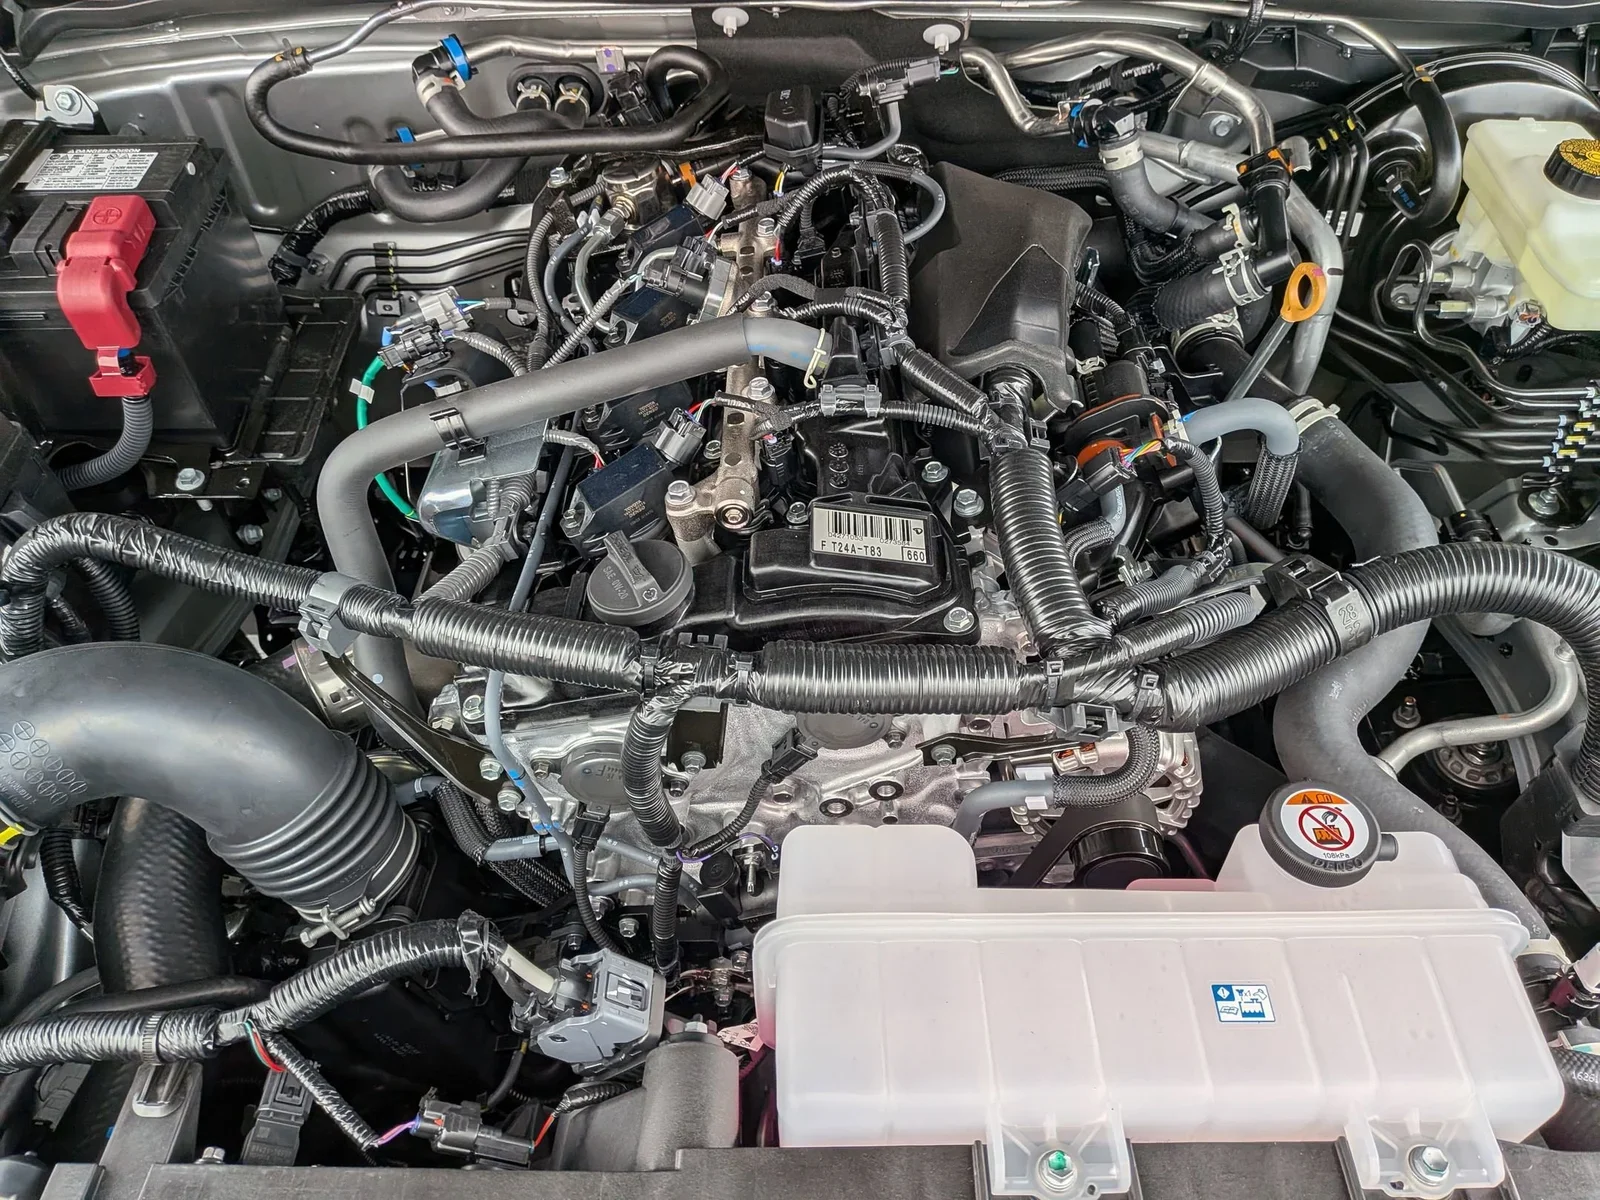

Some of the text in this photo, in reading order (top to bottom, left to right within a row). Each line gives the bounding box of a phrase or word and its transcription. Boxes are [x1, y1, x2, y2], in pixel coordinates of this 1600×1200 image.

[821, 540, 882, 557] F T24A-T83
[907, 549, 925, 562] 660
[603, 565, 617, 579] SAE
[1338, 602, 1358, 626] 28
[1344, 619, 1365, 642] 32
[1311, 857, 1364, 872] DENSO
